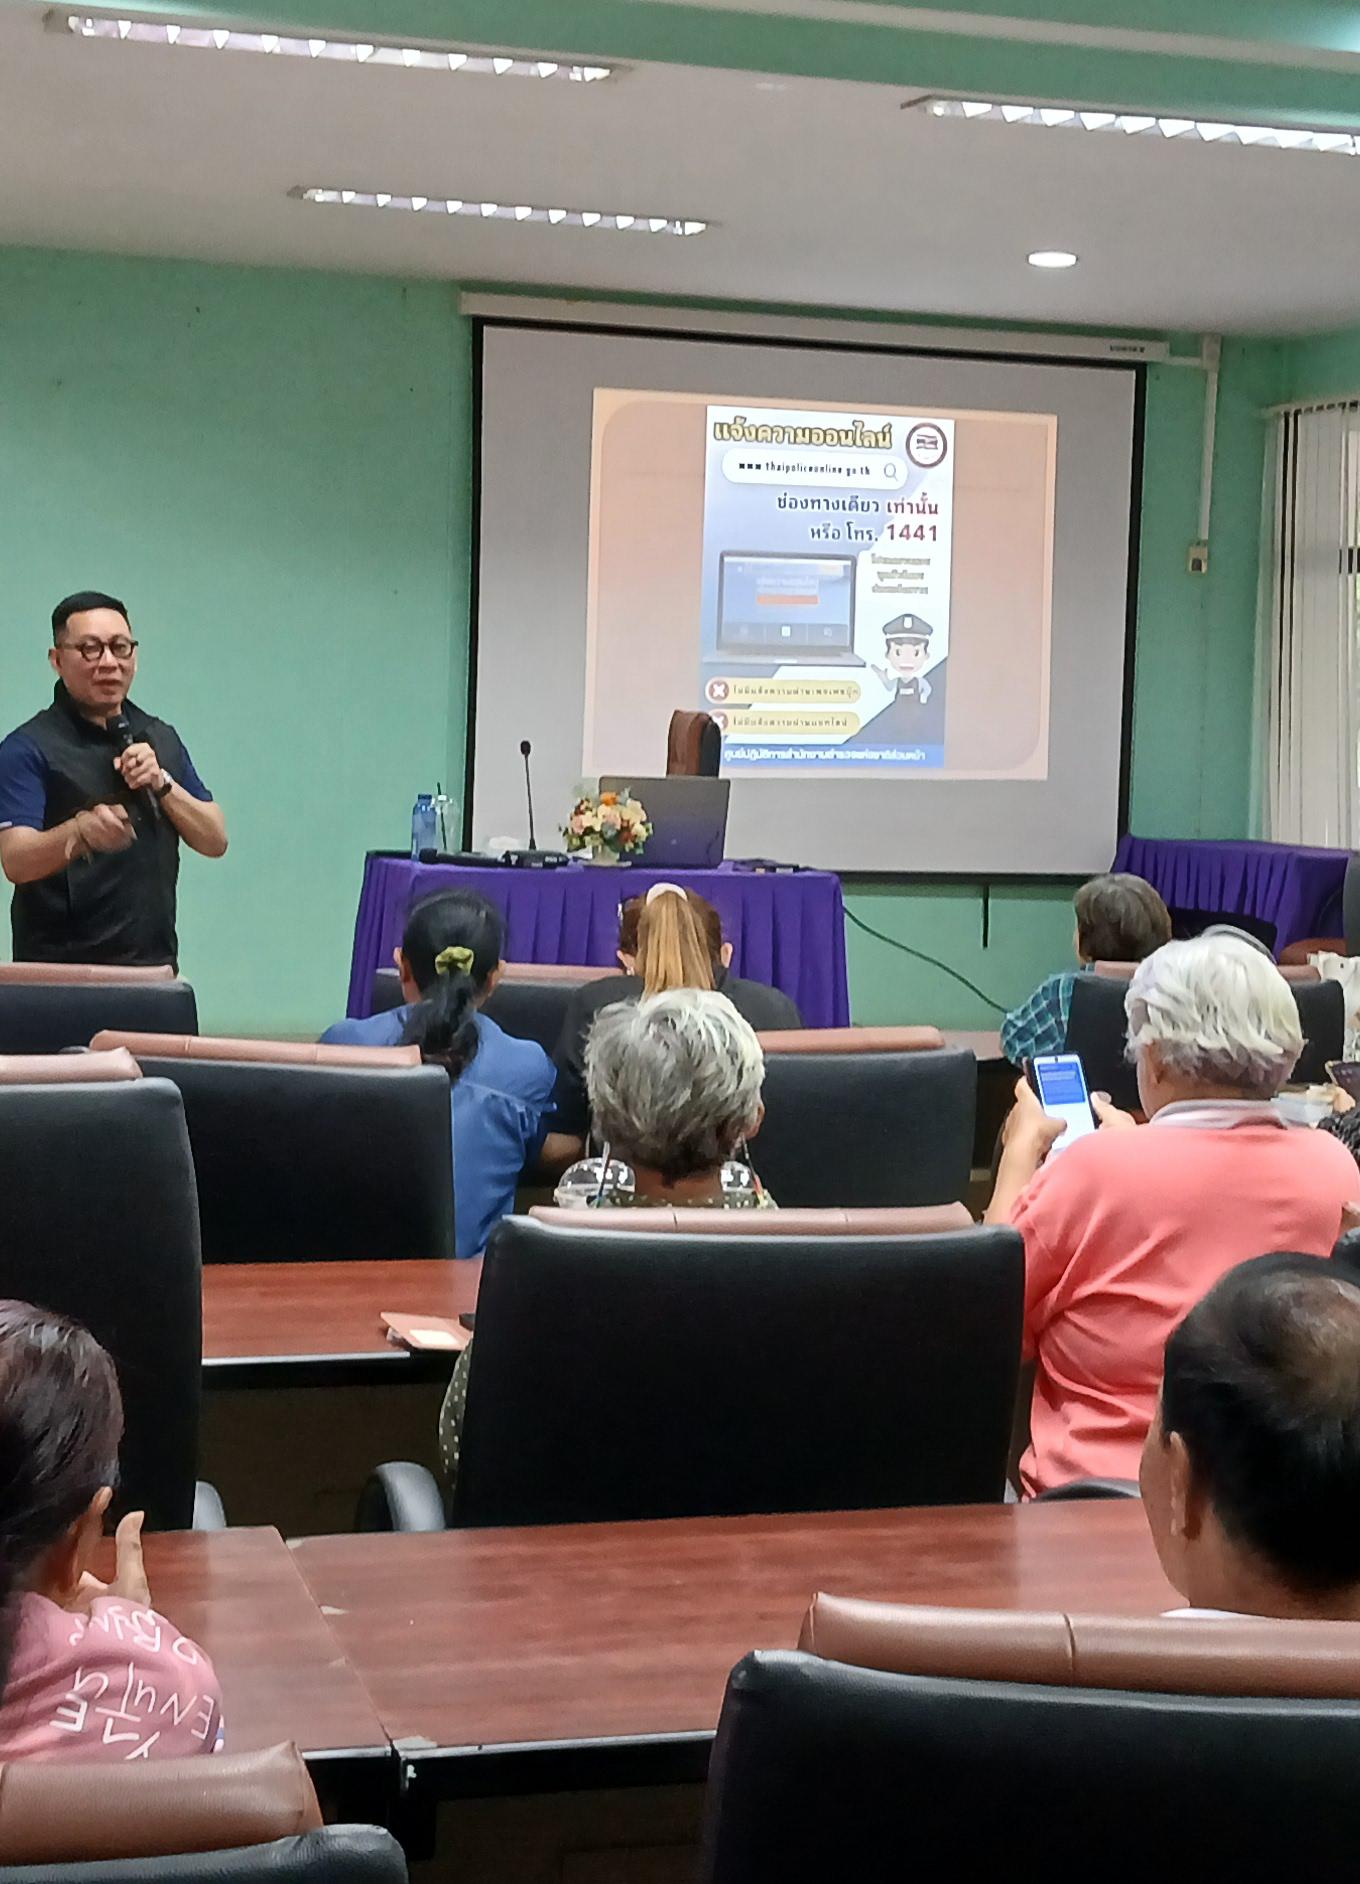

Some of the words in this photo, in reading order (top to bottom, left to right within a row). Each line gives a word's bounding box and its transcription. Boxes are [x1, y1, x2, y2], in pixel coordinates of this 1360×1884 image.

[714, 415, 893, 449] แจ้งความออนไลน์
[777, 493, 880, 513] ช่องทางเดียว
[886, 492, 939, 515] เท่านั้น
[810, 523, 841, 541] หรือ
[886, 523, 938, 542] 1441
